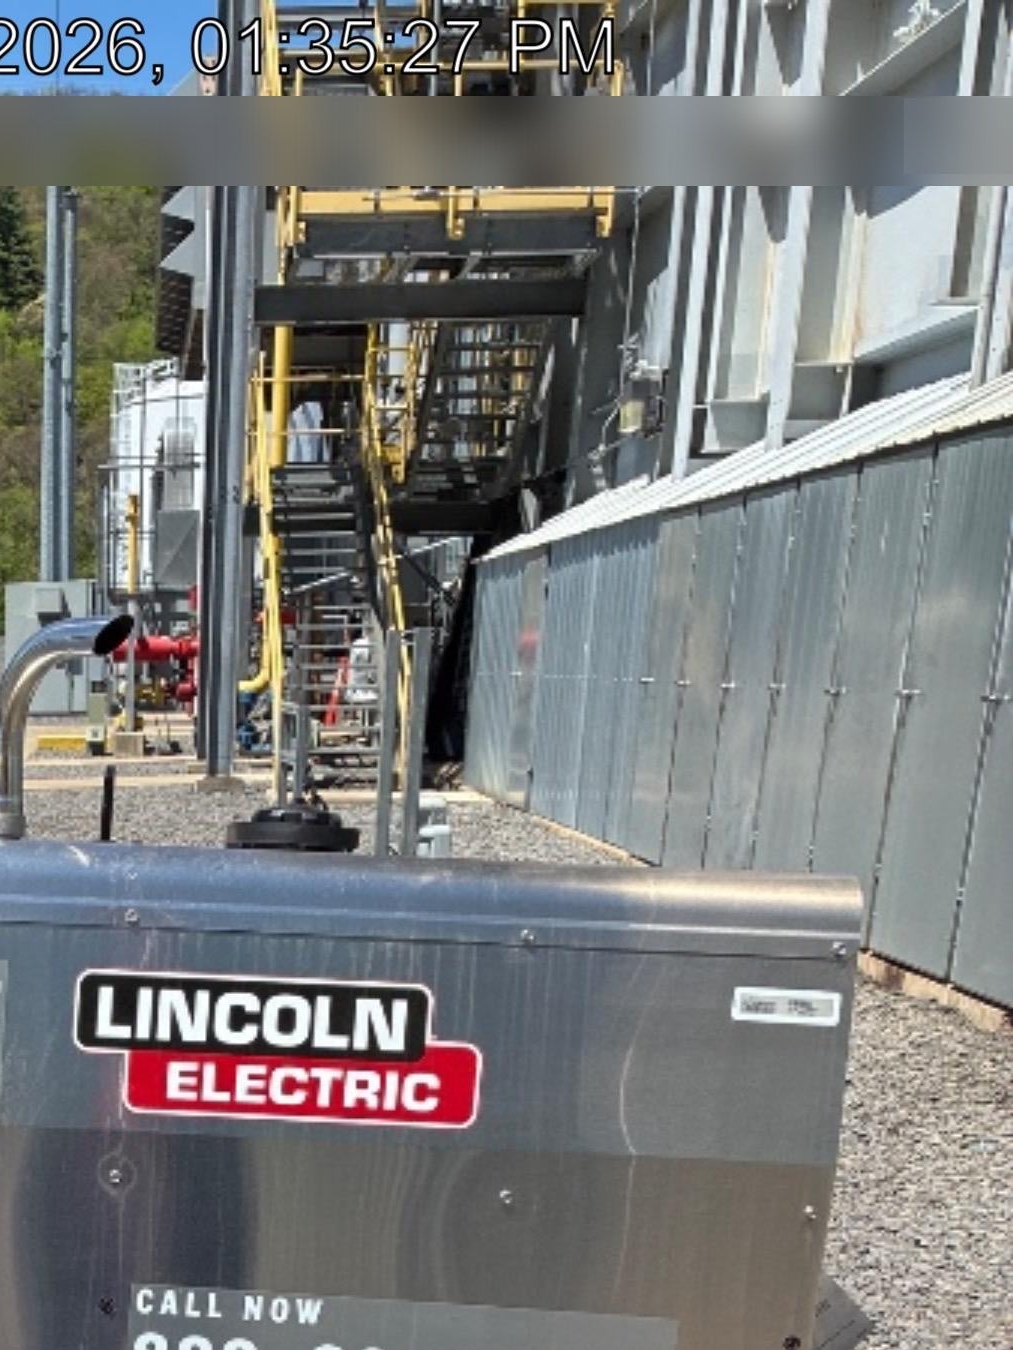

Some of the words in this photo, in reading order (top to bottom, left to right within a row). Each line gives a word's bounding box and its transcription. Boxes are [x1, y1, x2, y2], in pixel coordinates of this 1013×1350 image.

[95, 985, 409, 1052] LINCOLN
[165, 1061, 442, 1112] ELECTRIC
[135, 1288, 223, 1319] CALL
[243, 1294, 324, 1326] NOW
